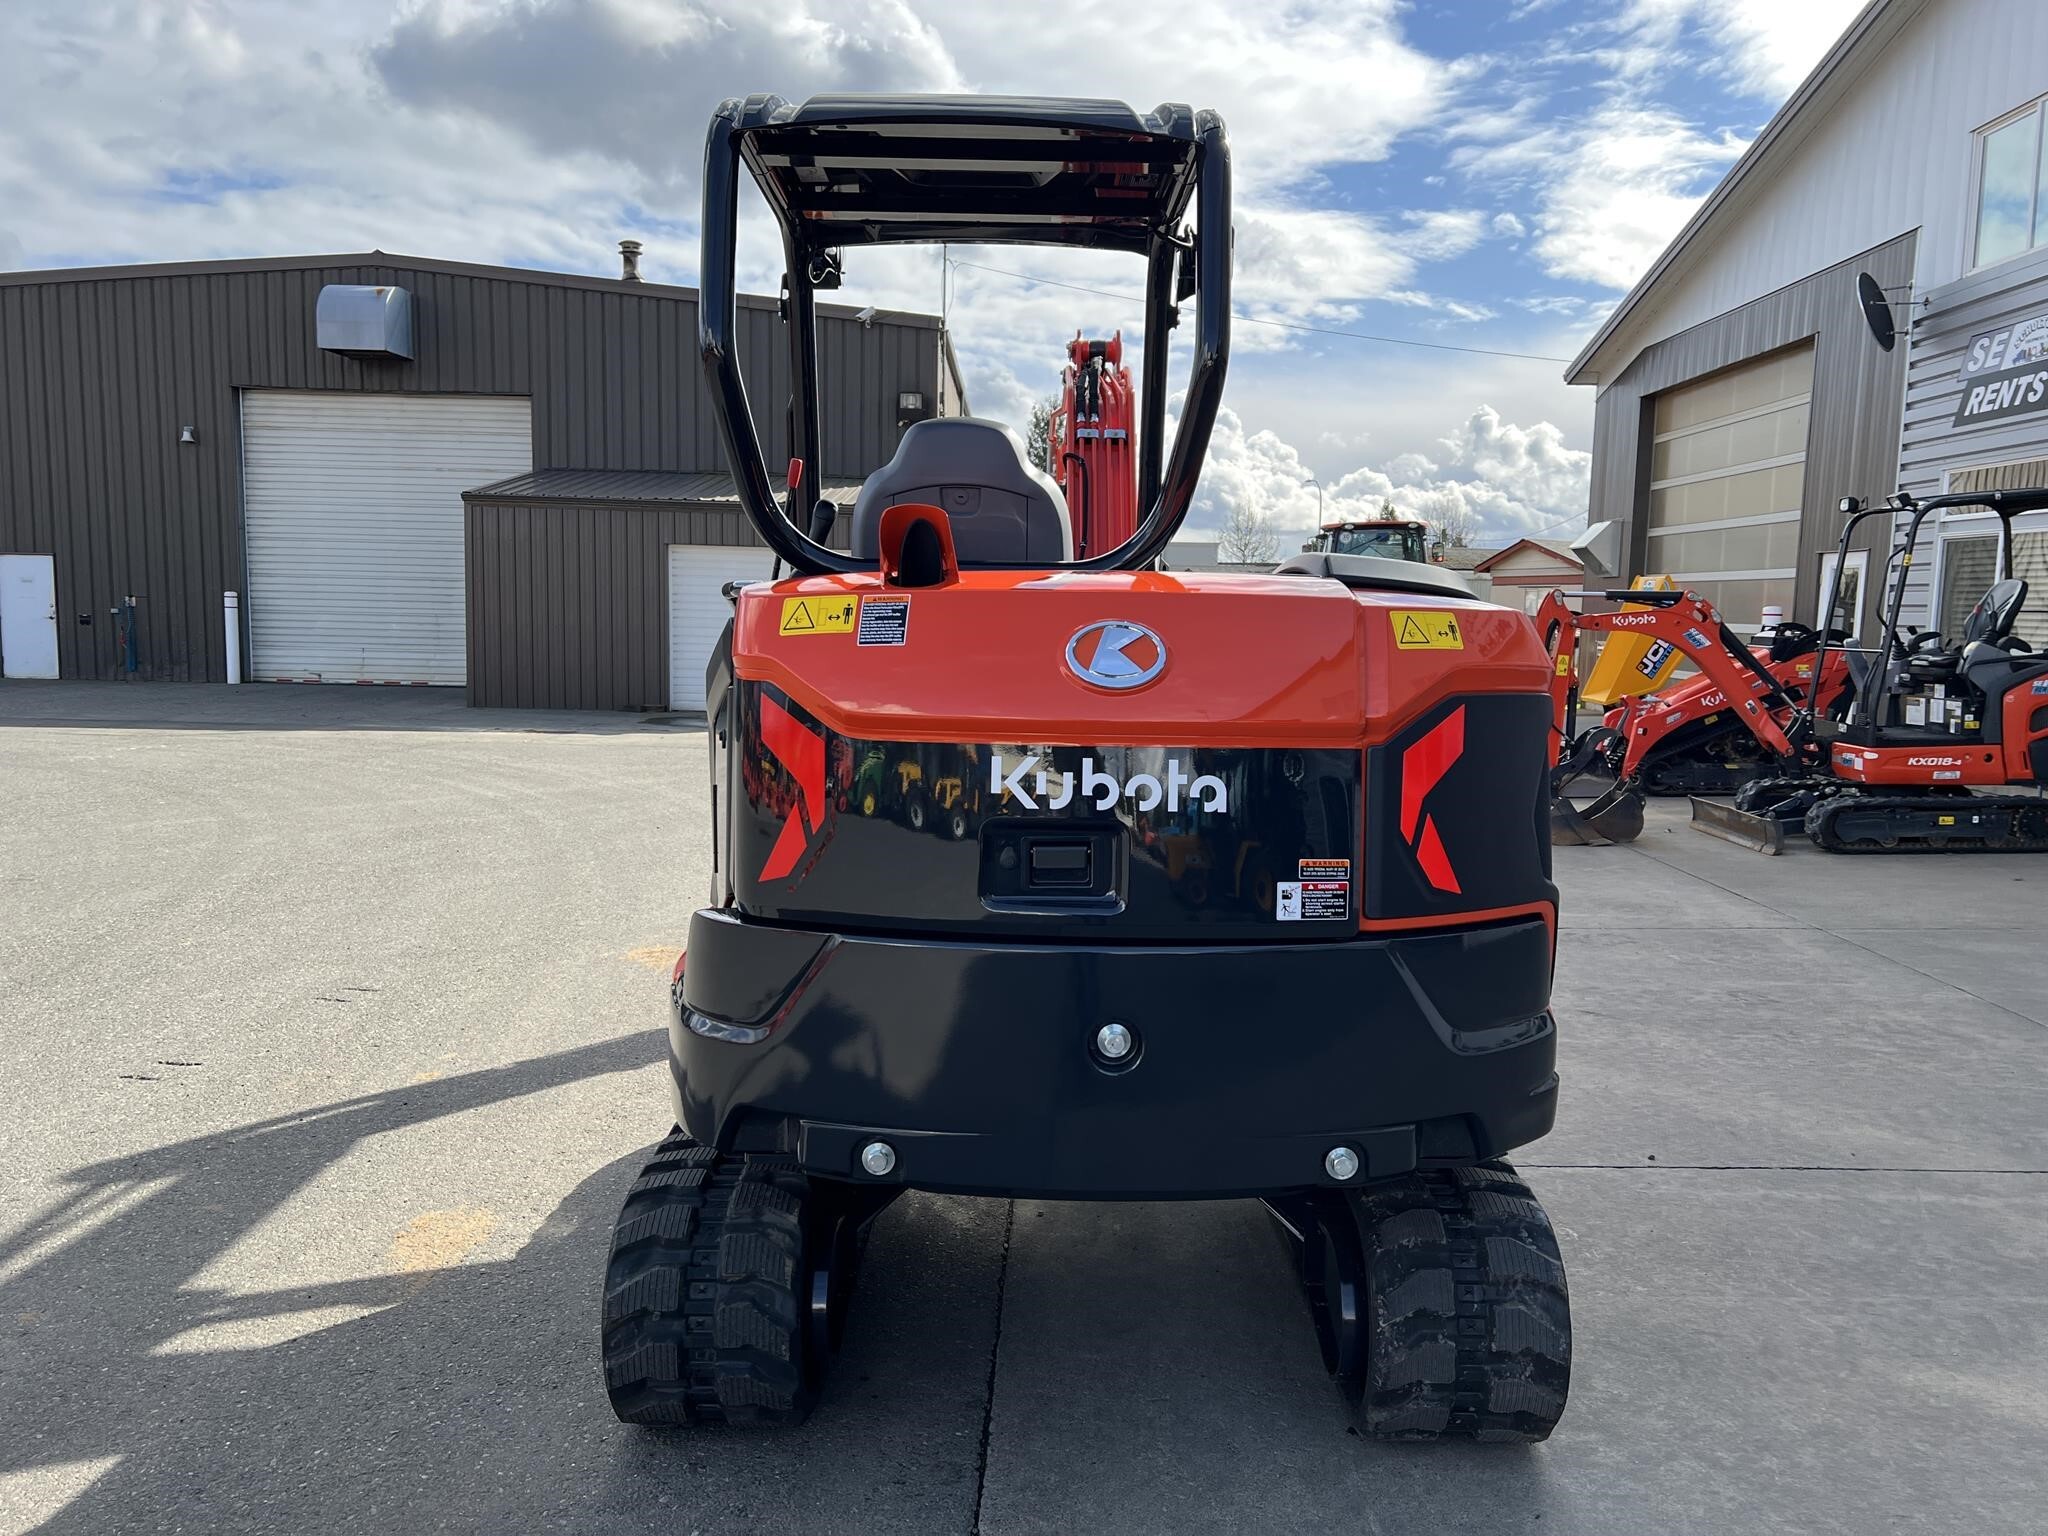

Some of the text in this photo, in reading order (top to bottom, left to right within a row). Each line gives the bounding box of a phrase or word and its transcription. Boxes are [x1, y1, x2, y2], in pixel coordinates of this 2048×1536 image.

[1963, 371, 2048, 417] RENTS
[1612, 614, 1656, 626] Kubota
[1907, 757, 1962, 766] KX018-4
[990, 755, 1228, 813] Kubota
